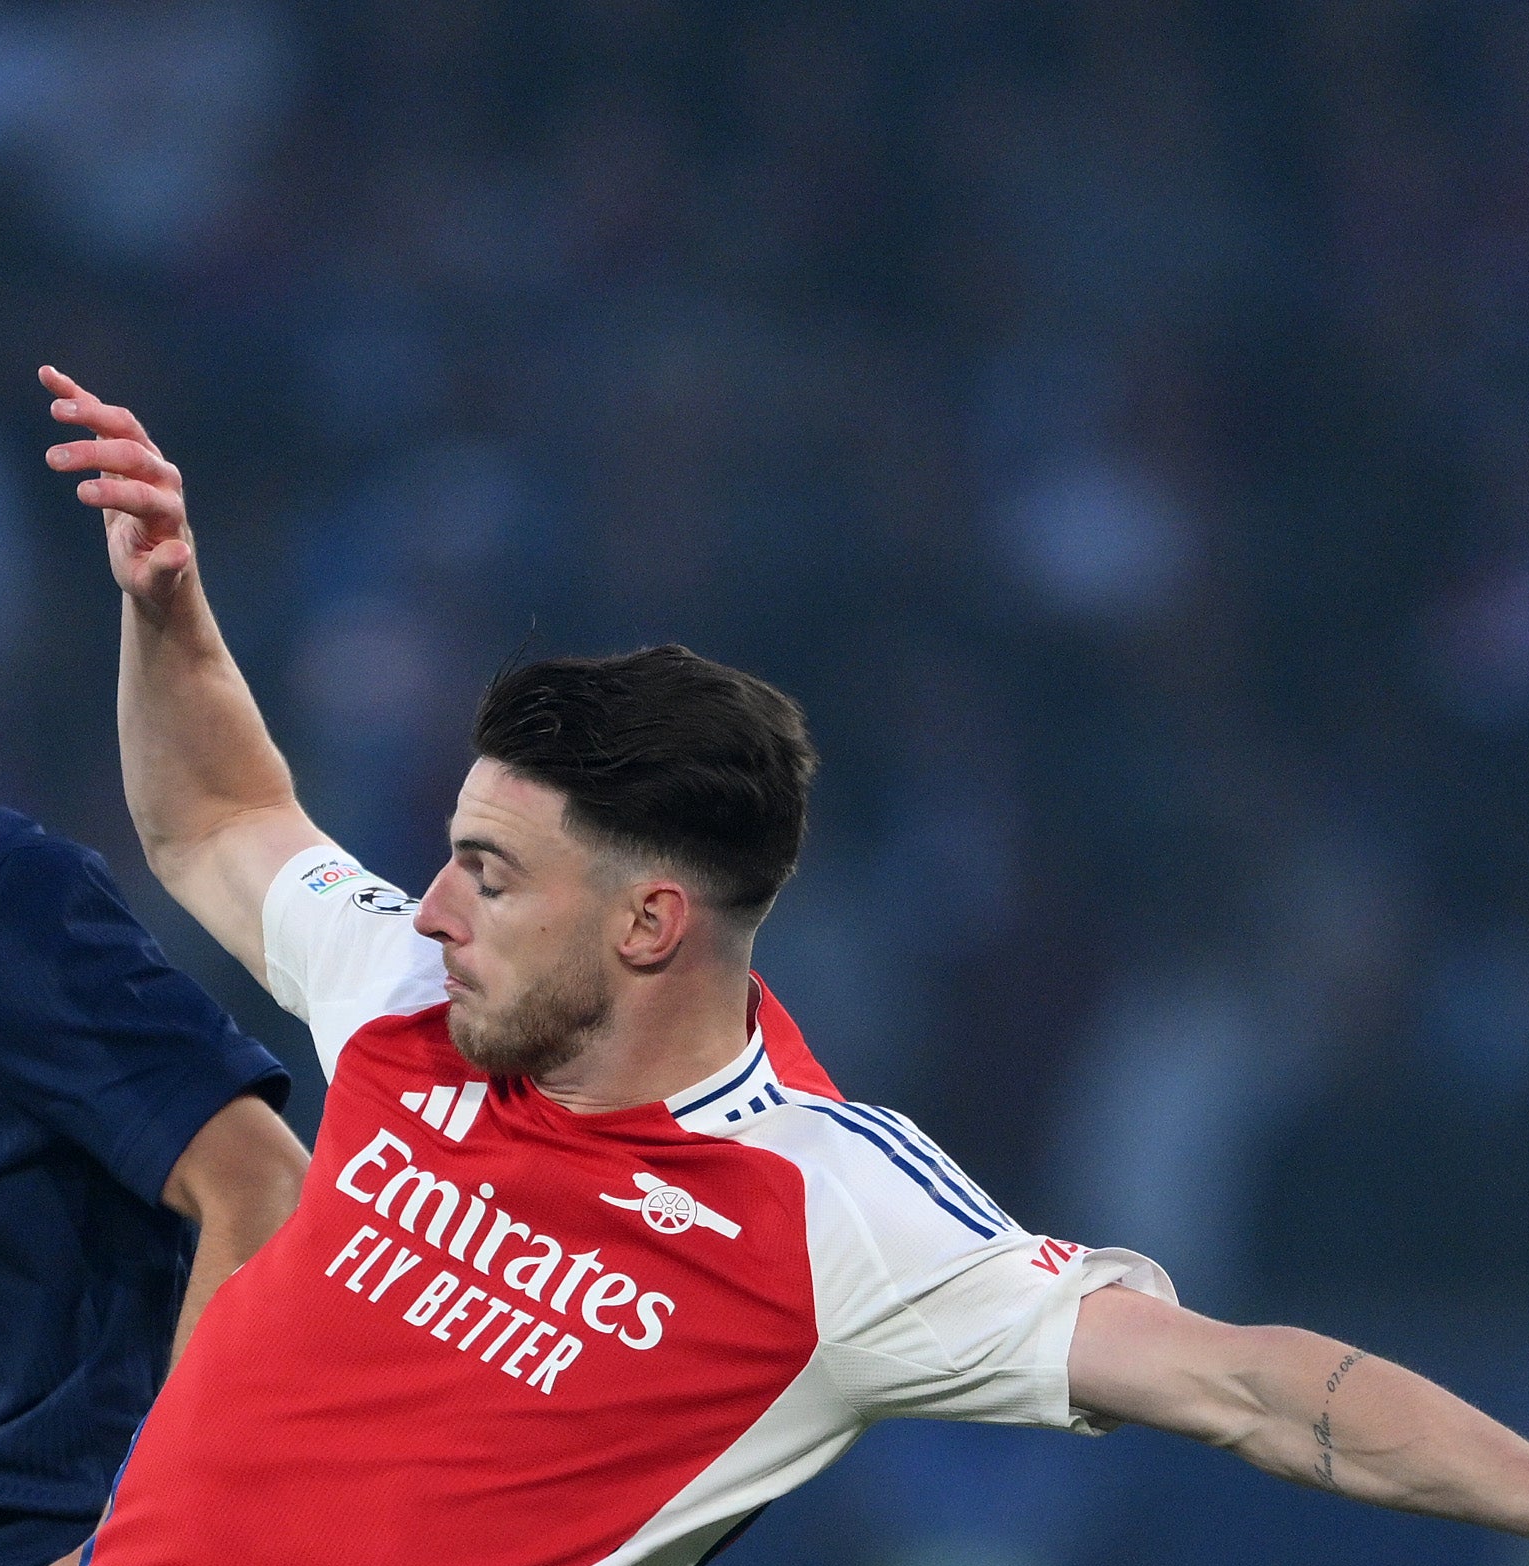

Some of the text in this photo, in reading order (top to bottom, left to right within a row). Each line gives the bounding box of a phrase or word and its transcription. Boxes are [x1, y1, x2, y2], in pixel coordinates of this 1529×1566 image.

[324, 1225, 584, 1396] FLY BETTER
[335, 1127, 676, 1351] Emirates
